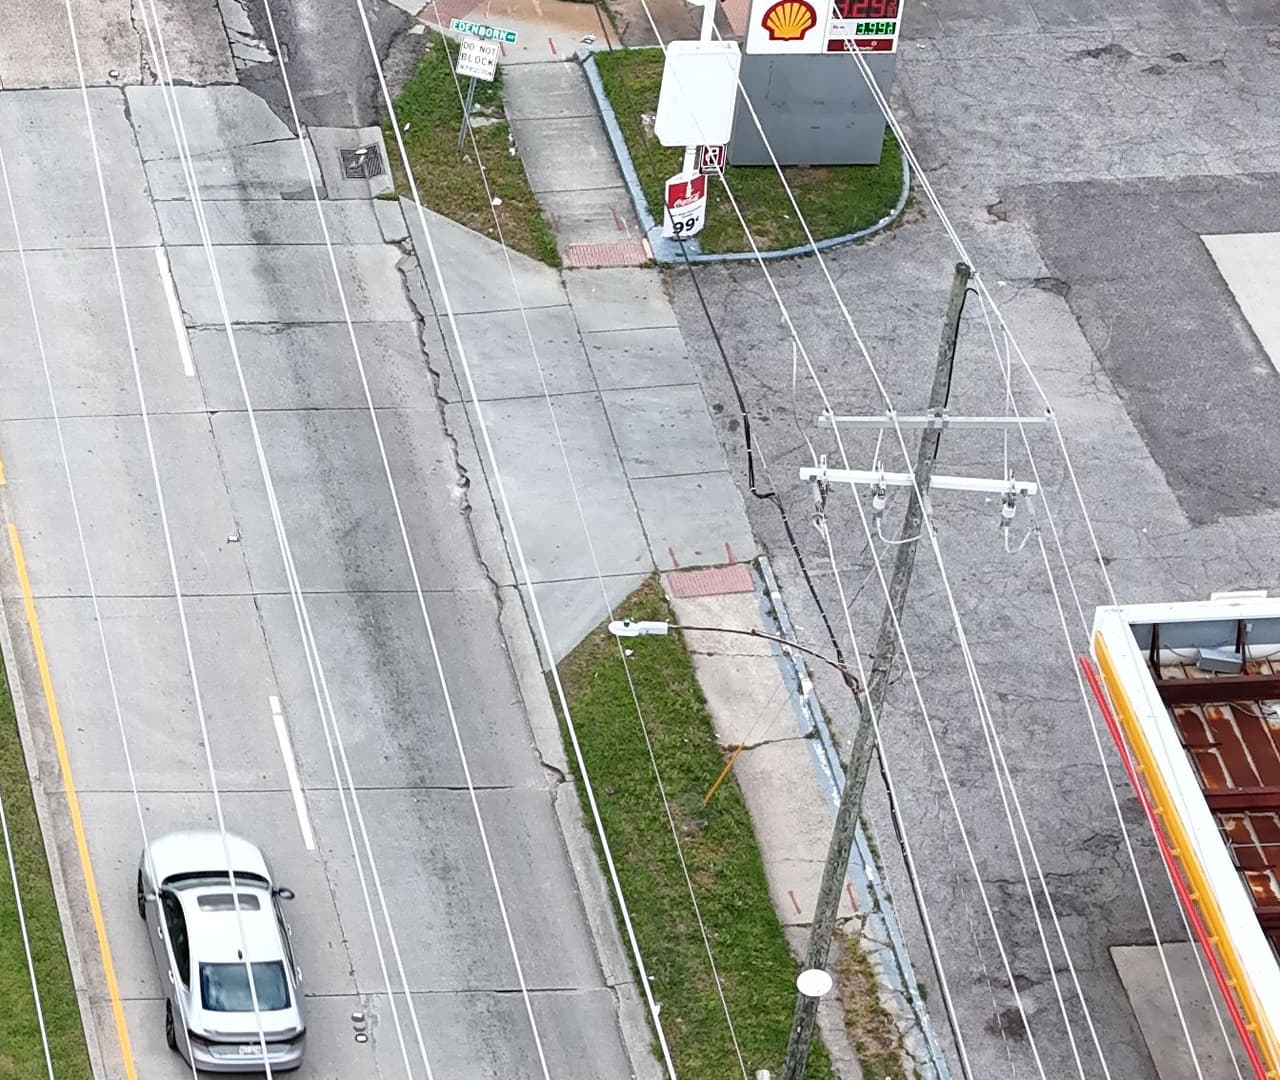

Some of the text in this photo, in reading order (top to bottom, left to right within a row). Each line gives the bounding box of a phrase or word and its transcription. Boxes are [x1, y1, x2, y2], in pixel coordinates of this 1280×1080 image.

[452, 21, 507, 41] EDENBORN
[463, 41, 496, 56] DO NOT
[461, 52, 494, 67] BLOCK
